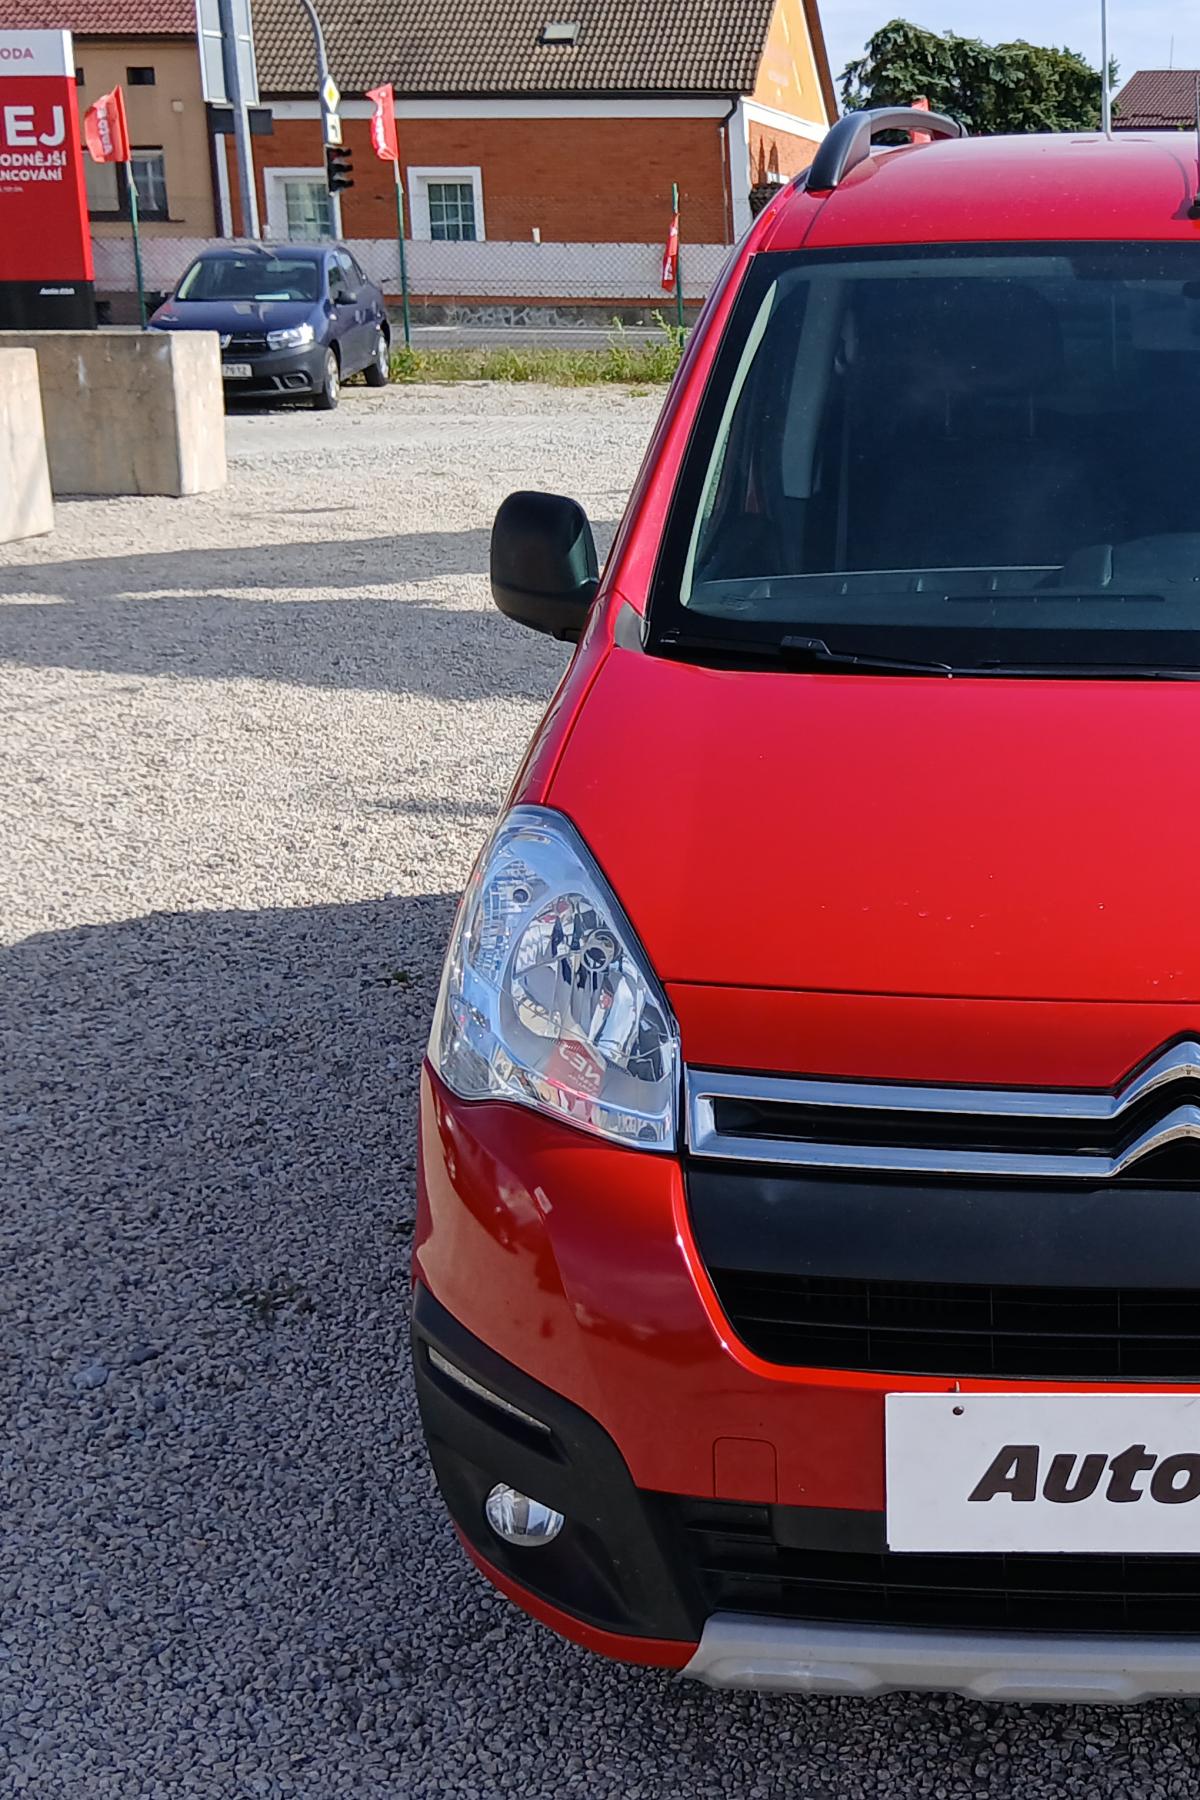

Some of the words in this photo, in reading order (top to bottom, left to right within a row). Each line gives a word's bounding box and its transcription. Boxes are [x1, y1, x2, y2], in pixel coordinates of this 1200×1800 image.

[0, 47, 34, 60] ODA
[3, 105, 66, 146] EJ
[0, 166, 63, 181] NCOVÁNÍ
